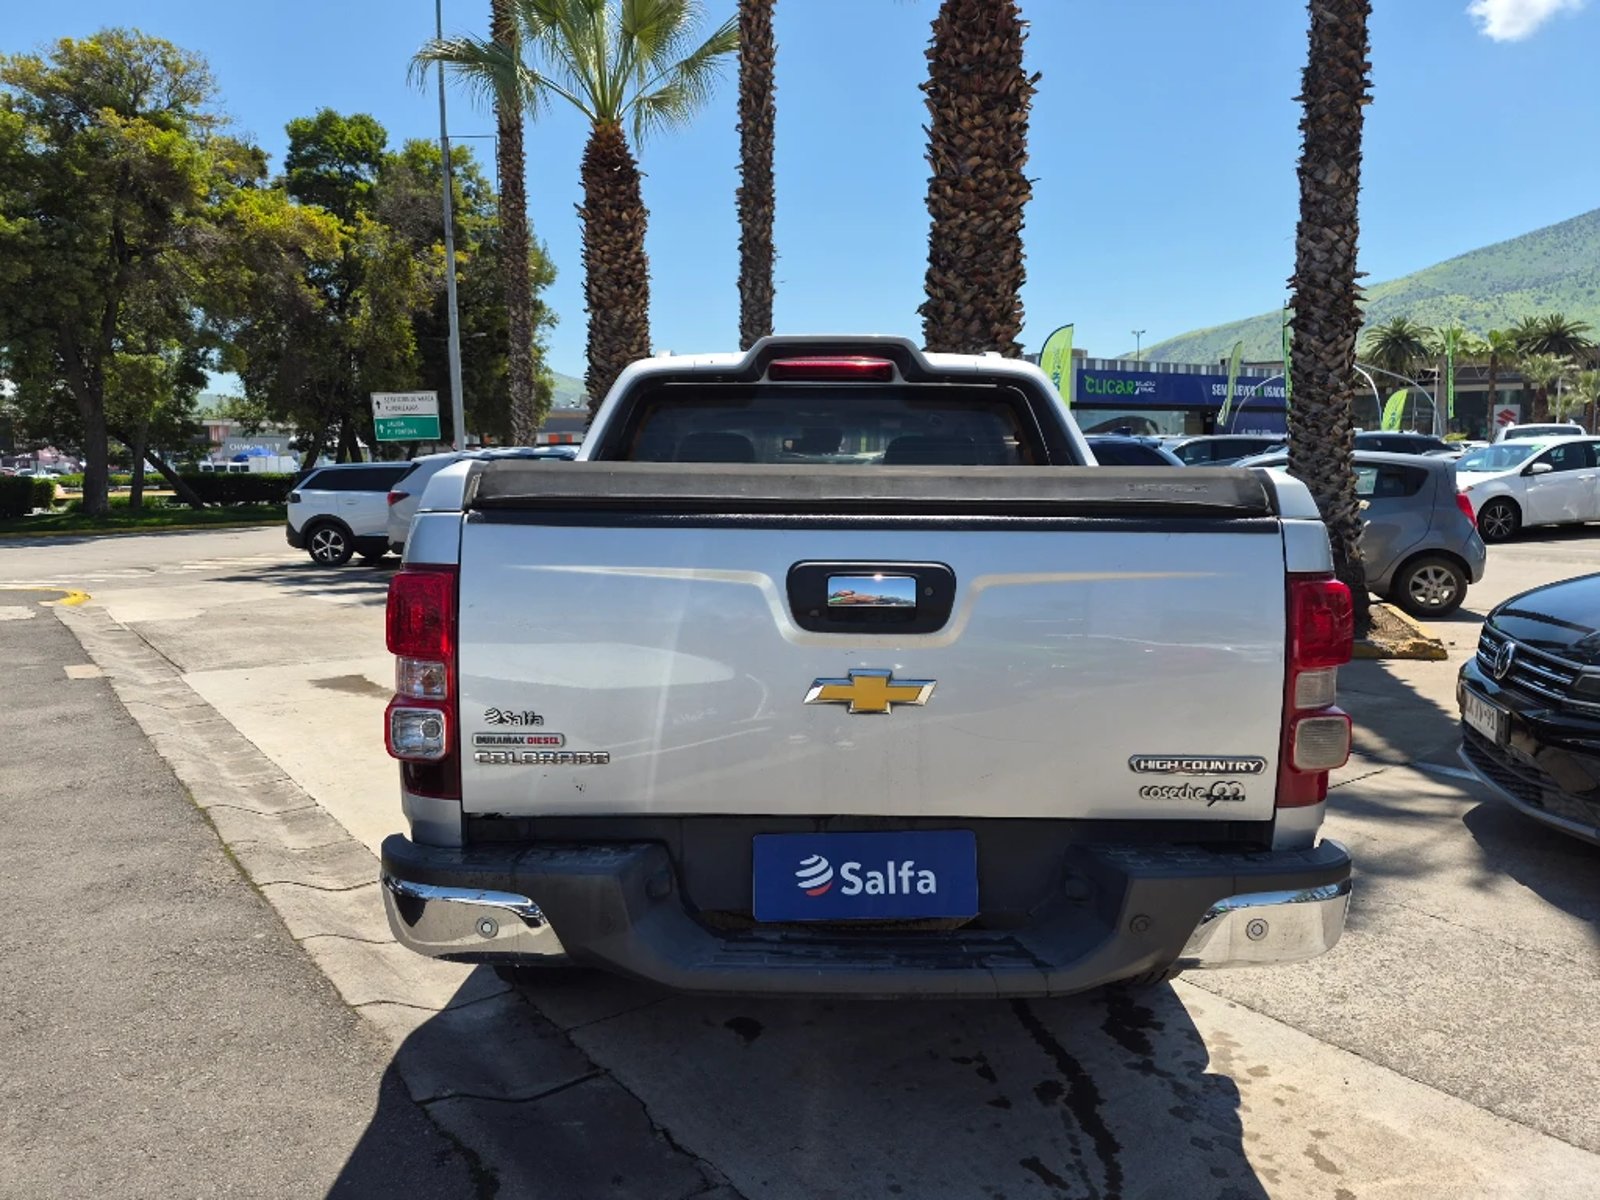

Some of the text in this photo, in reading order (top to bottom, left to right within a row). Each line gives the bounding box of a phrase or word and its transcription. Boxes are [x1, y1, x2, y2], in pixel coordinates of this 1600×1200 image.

[502, 710, 544, 726] Salfa
[476, 736, 560, 744] DURAMAX DIESEL
[474, 751, 610, 764] COLORADO
[1140, 760, 1259, 771] HIGH COUNTRY
[840, 860, 937, 895] Salfa
